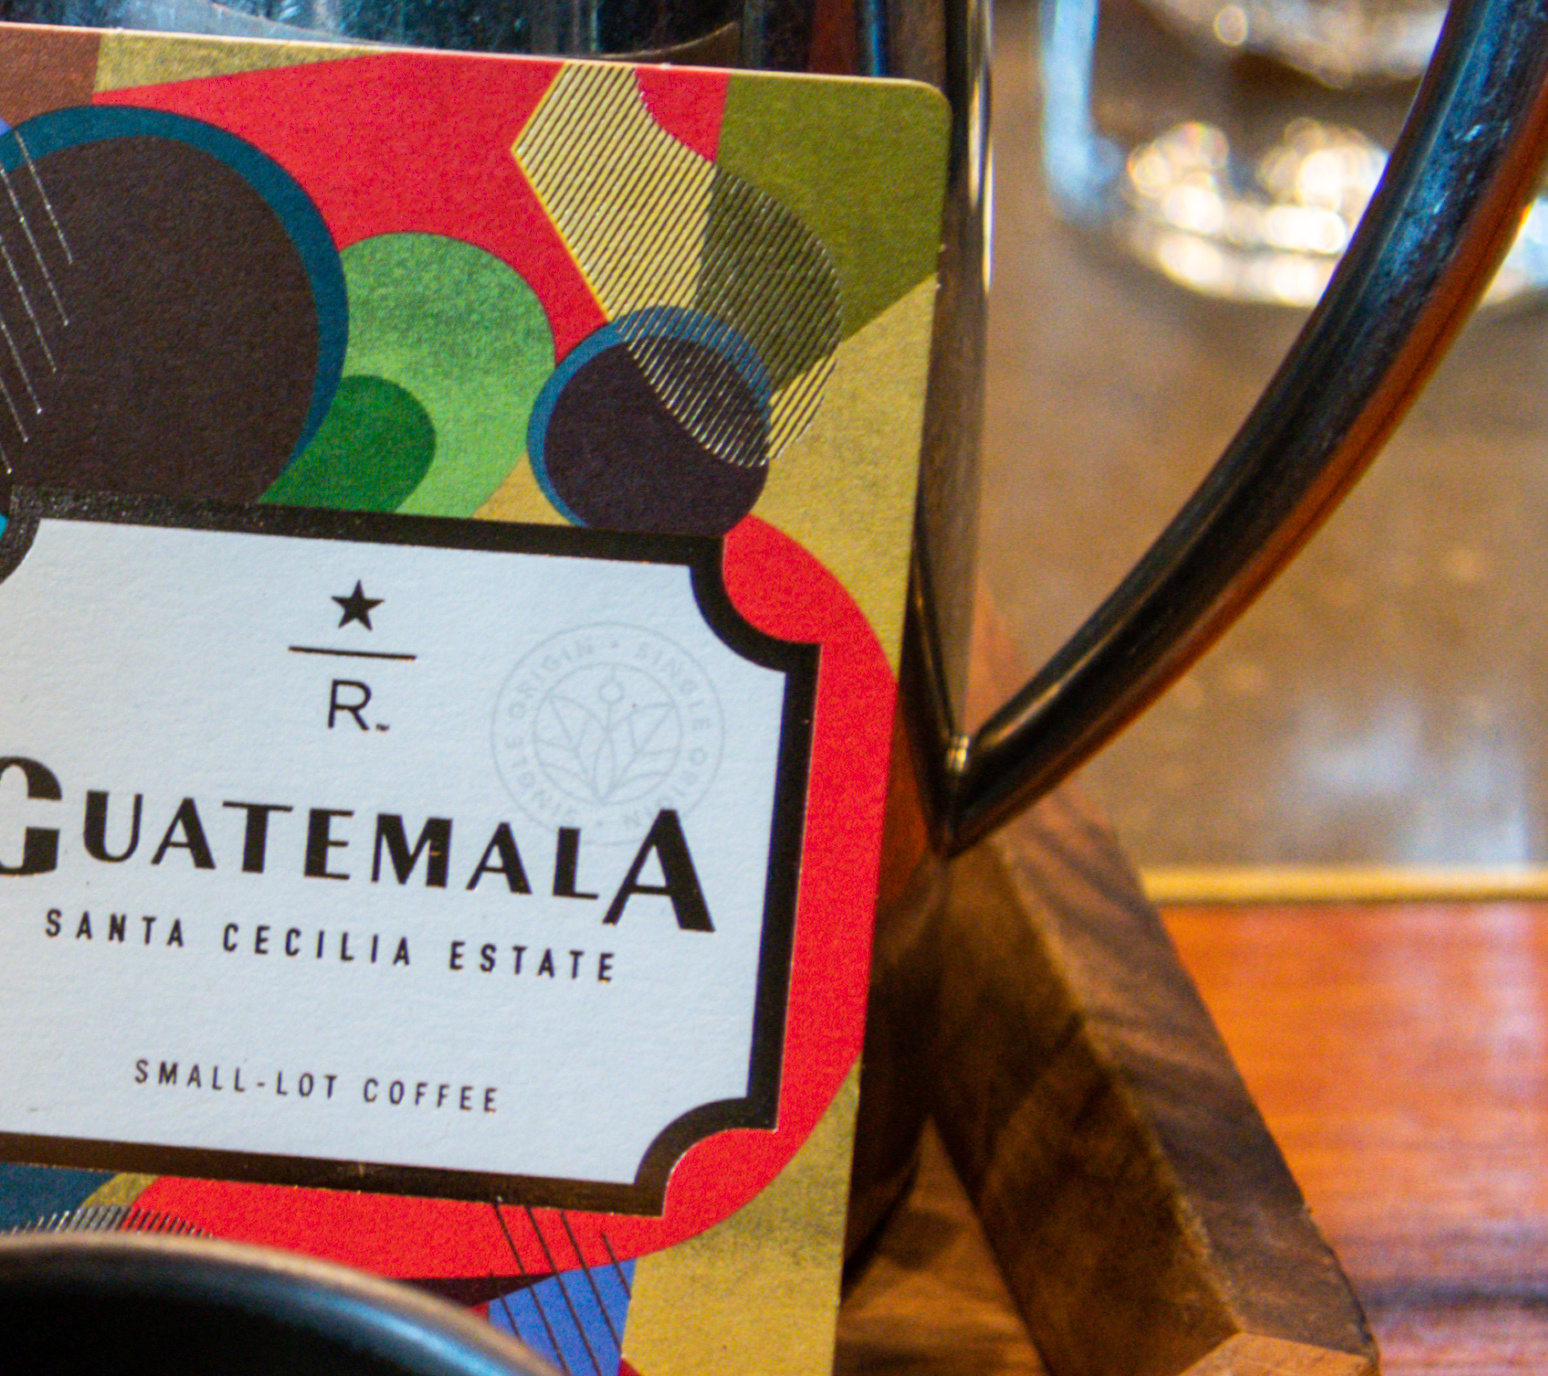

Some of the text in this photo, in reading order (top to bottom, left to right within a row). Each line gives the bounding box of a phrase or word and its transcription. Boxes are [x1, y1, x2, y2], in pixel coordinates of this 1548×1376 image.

[508, 641, 593, 719] ORIGIN
[635, 641, 710, 729] SINGLE
[45, 908, 614, 982] SANTA CECILIA ESTATE
[135, 1059, 497, 1113] SMALL-LOT COFFEE
